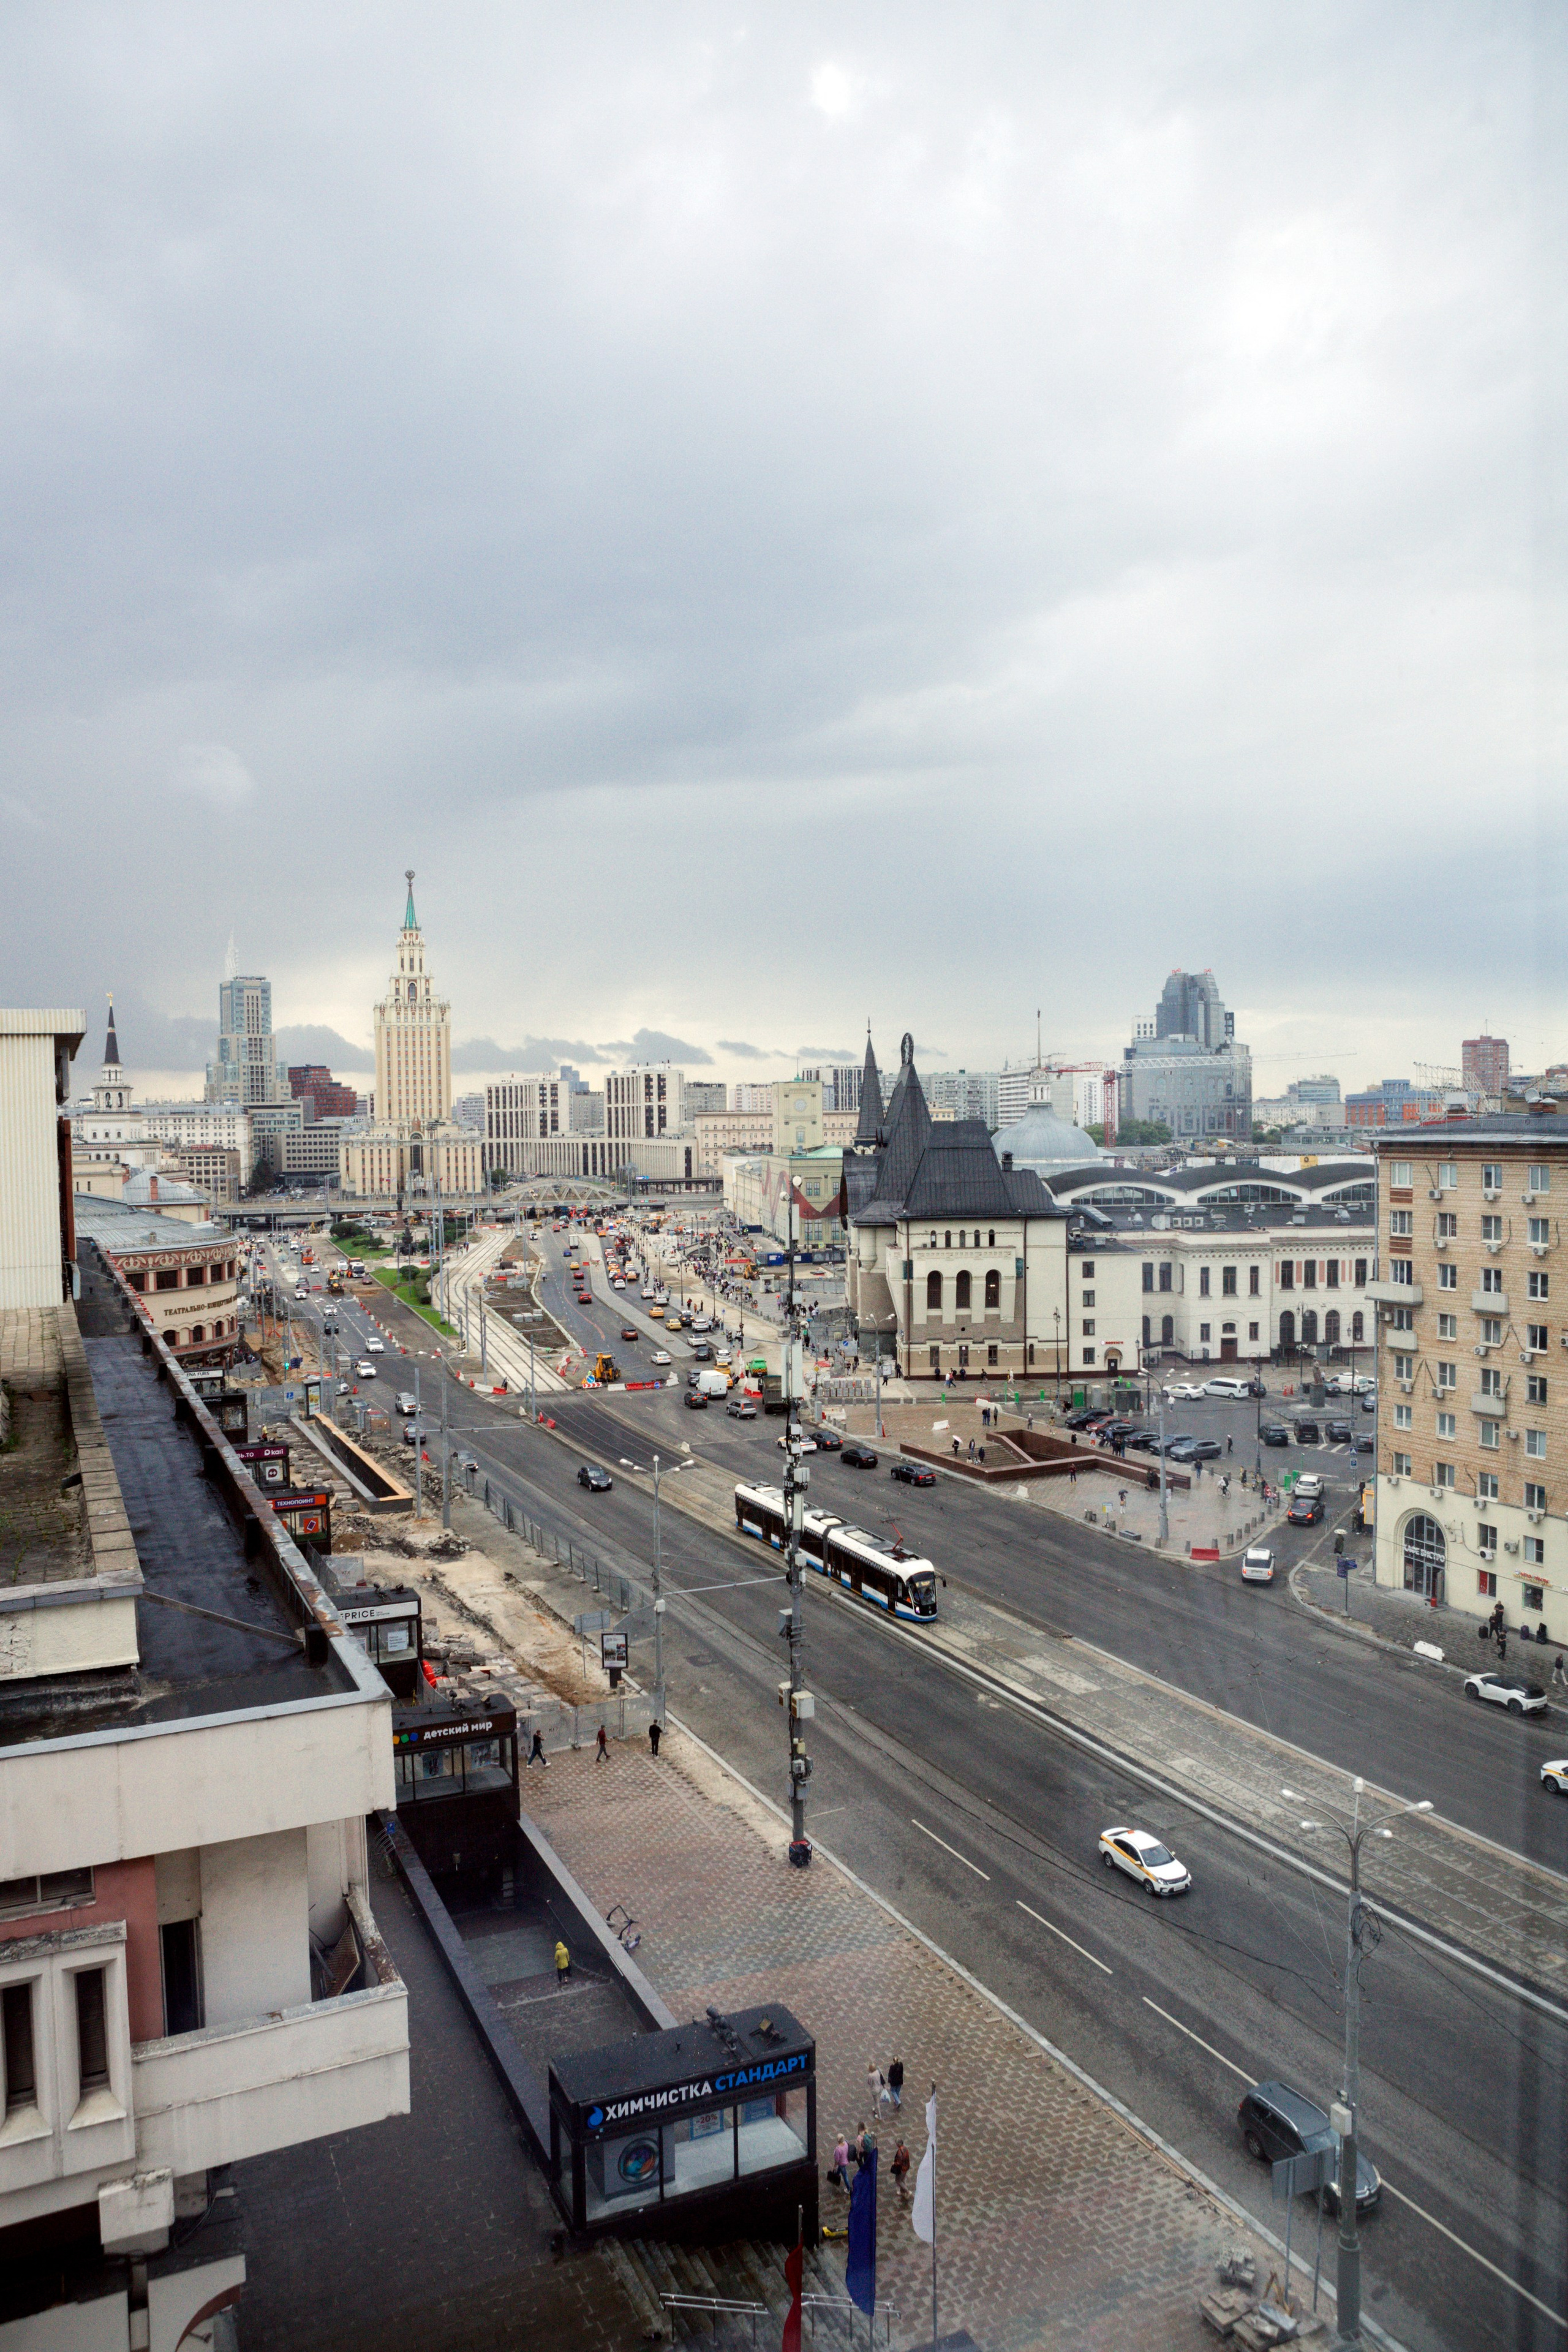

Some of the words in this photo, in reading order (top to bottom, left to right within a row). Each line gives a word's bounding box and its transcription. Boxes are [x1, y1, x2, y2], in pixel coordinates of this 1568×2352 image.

[276, 1498, 314, 1506] ТЕХНОПОИНТ
[423, 1723, 469, 1740] детский
[471, 1721, 493, 1732] мир
[605, 2081, 712, 2121] ХИМЧИСТКА
[715, 2054, 808, 2091] СТАНДАРТ
